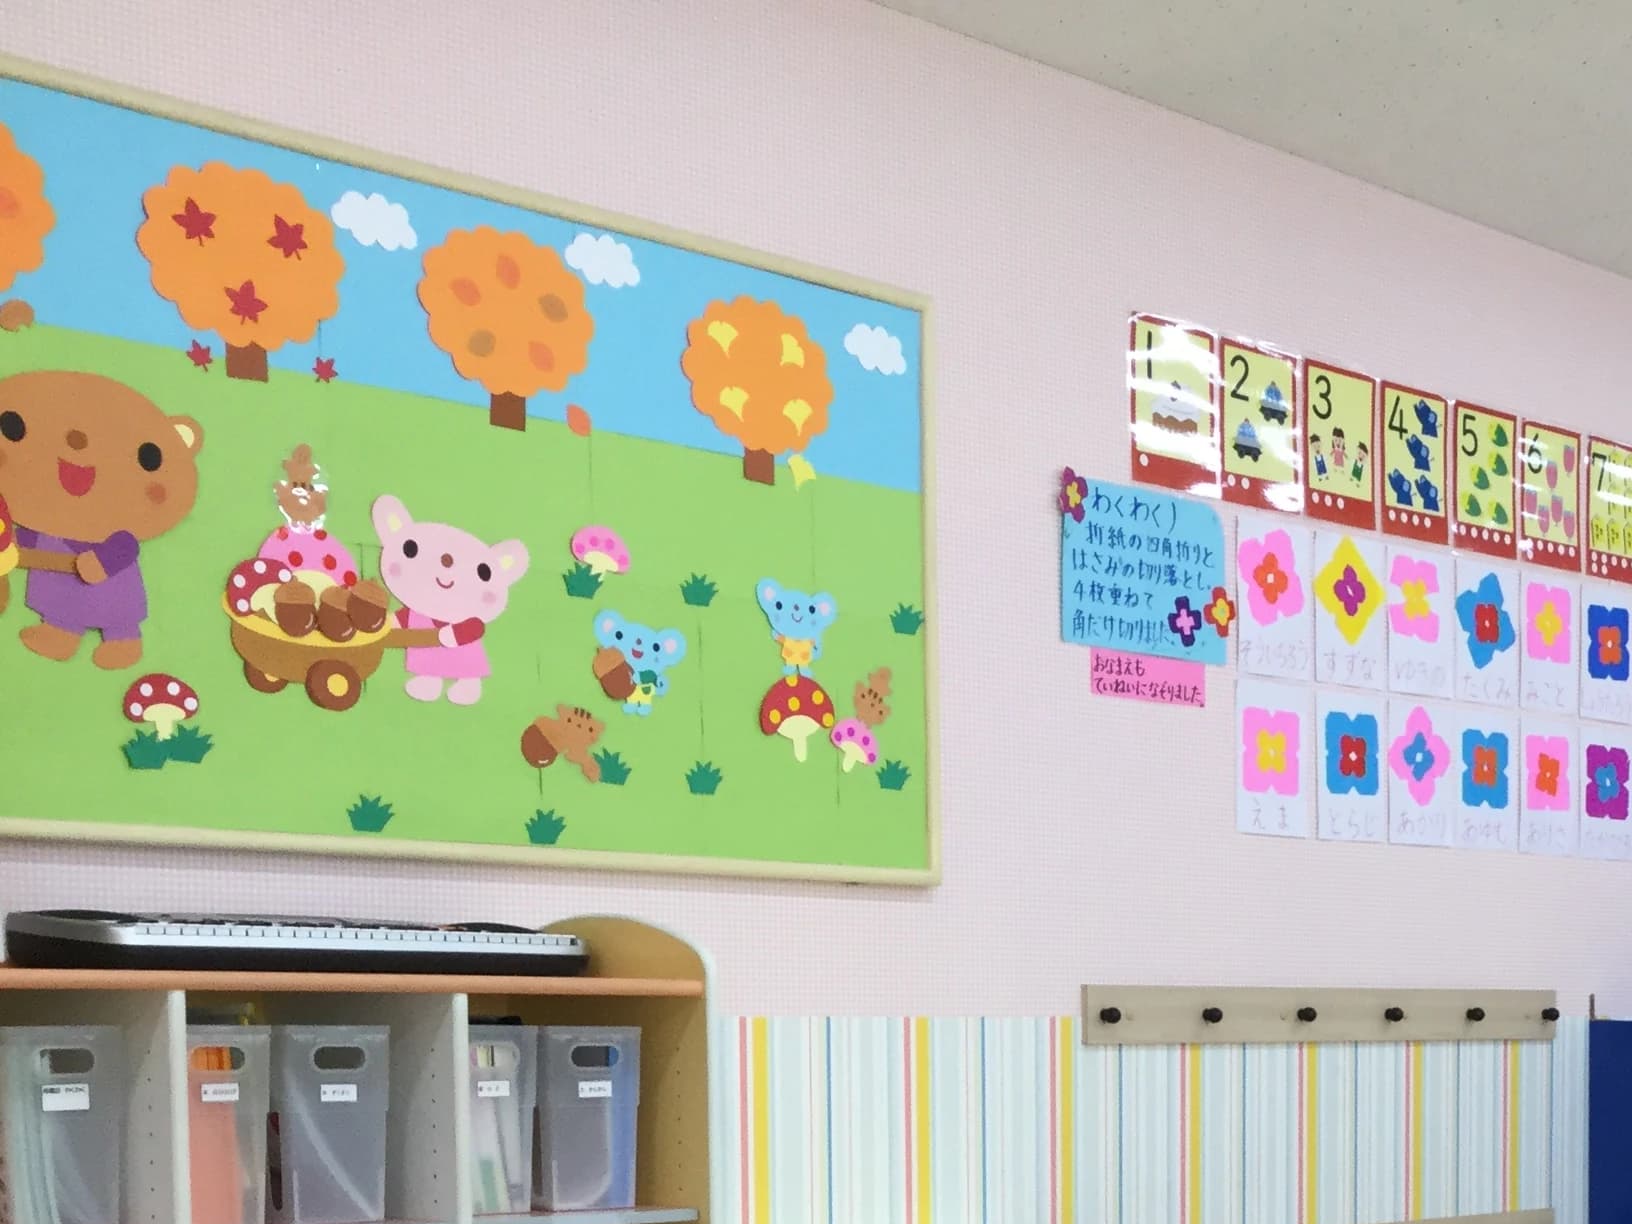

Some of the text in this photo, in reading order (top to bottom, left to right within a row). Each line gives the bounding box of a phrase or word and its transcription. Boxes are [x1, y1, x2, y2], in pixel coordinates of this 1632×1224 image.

[1230, 355, 1250, 402] 2
[1312, 375, 1333, 420] 3
[1388, 395, 1408, 440] 4
[1460, 413, 1479, 457] 5
[1526, 433, 1544, 474] 6
[1591, 451, 1607, 492] 7
[1093, 653, 1146, 677] おなまえも
